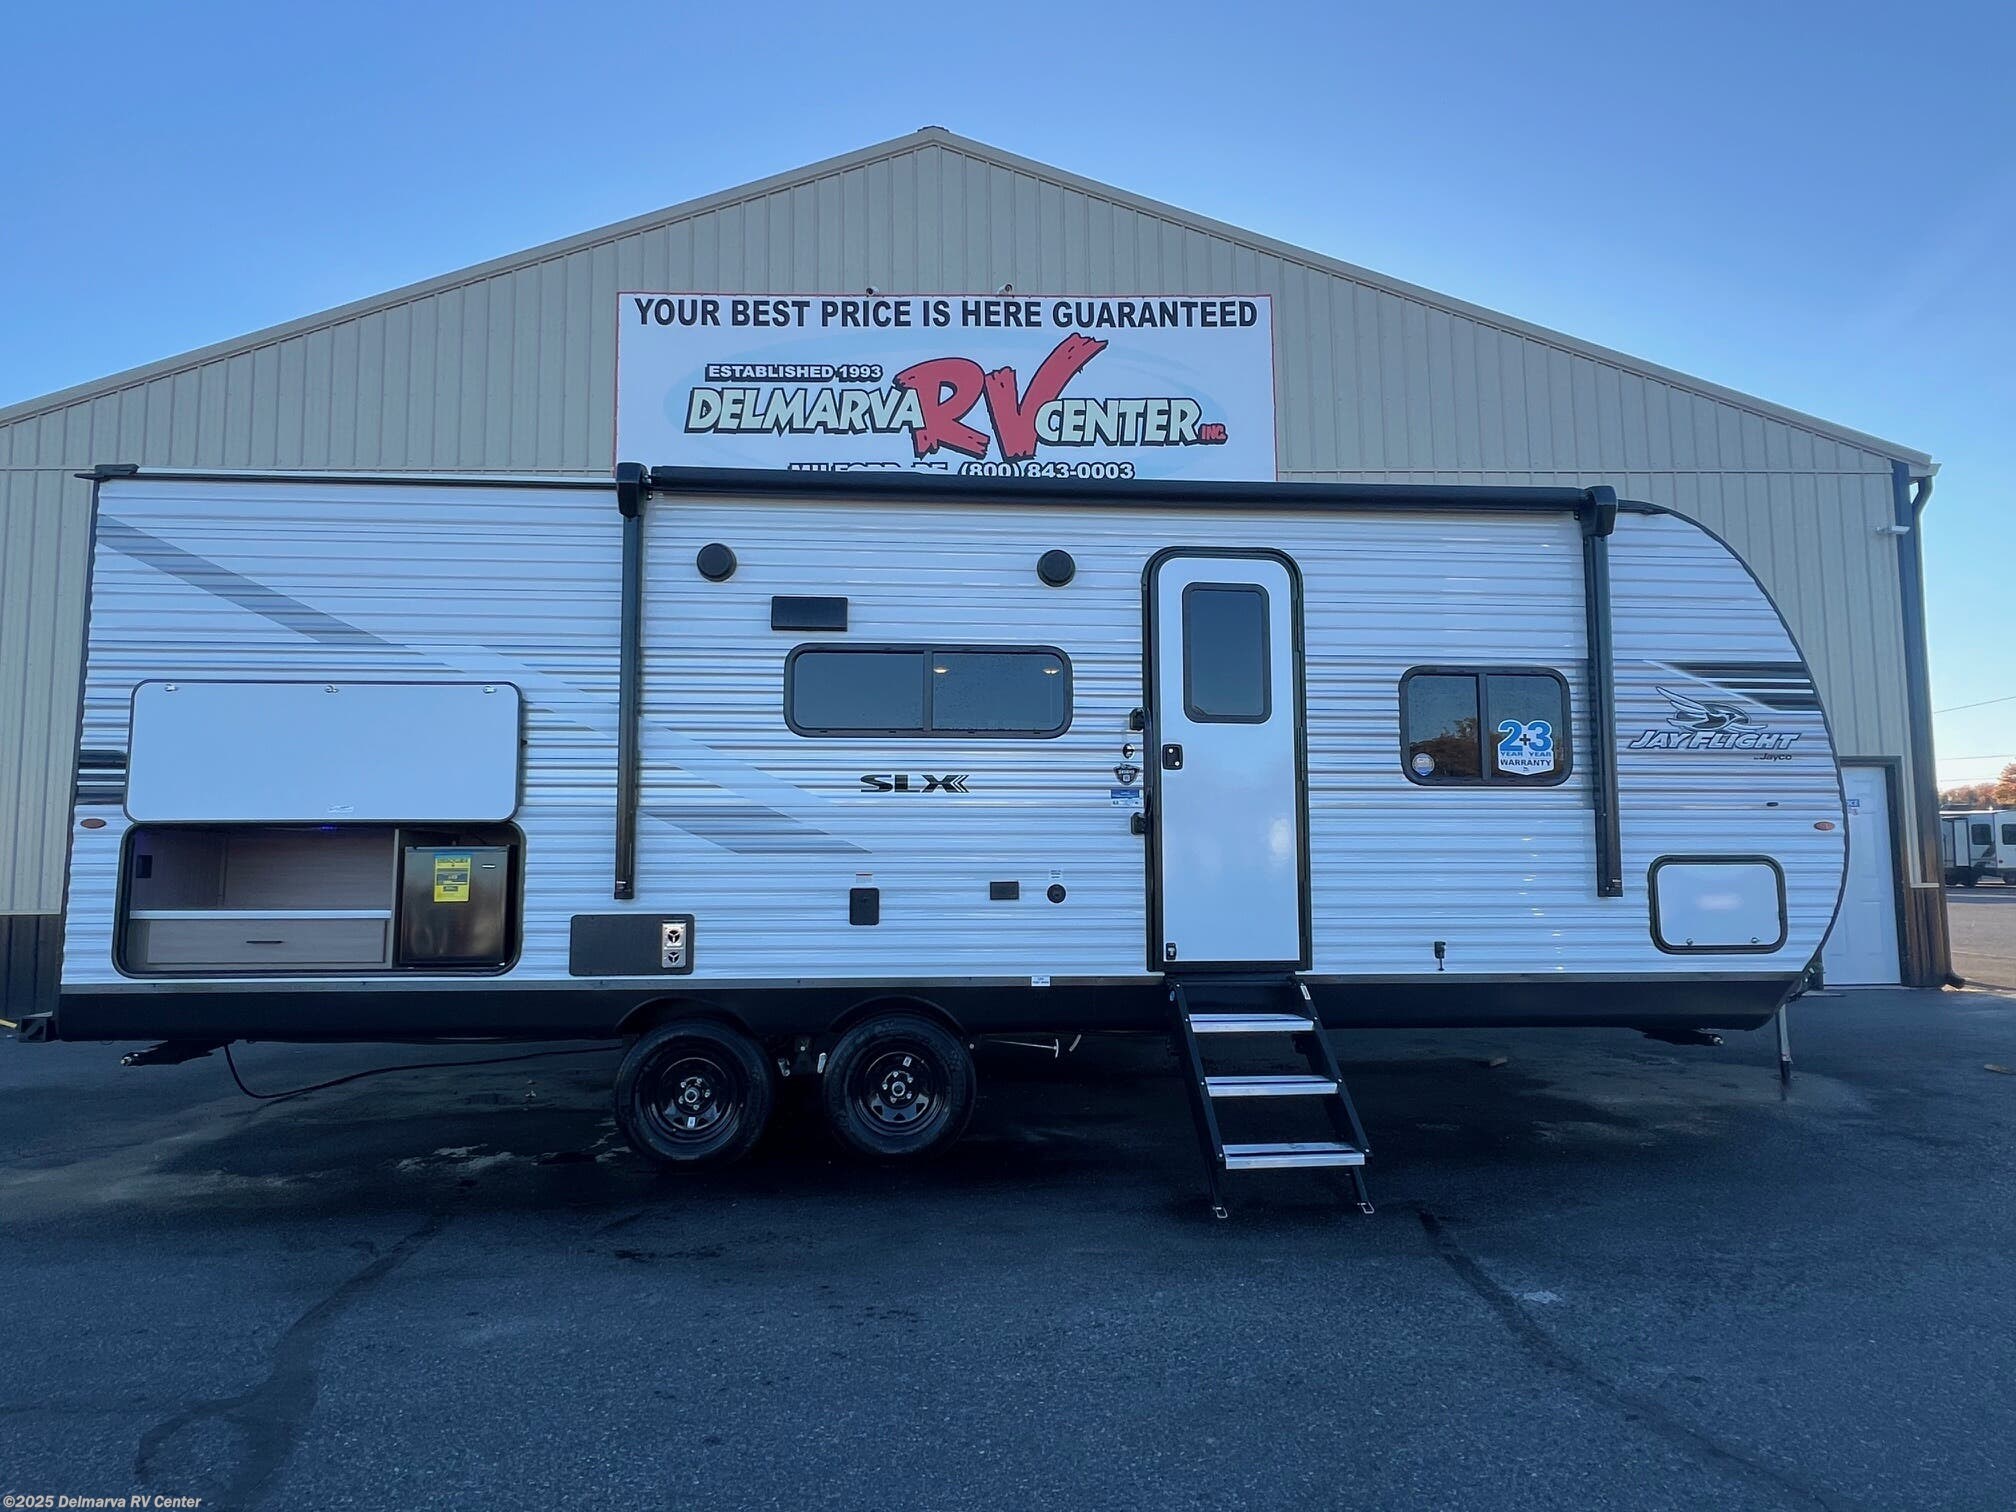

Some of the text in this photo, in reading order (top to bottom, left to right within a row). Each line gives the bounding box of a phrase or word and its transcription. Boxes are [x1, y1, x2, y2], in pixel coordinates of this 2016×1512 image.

[634, 298, 1257, 328] YOUR BEST PRICE IS HERE GUARANTEED
[707, 364, 883, 380] ESTABLISHED 1993
[685, 332, 1228, 462] DELMARVA RV CENTER INC.
[961, 462, 1020, 477] (800)
[1026, 462, 1136, 479] 843-0003
[860, 774, 970, 793] SLX
